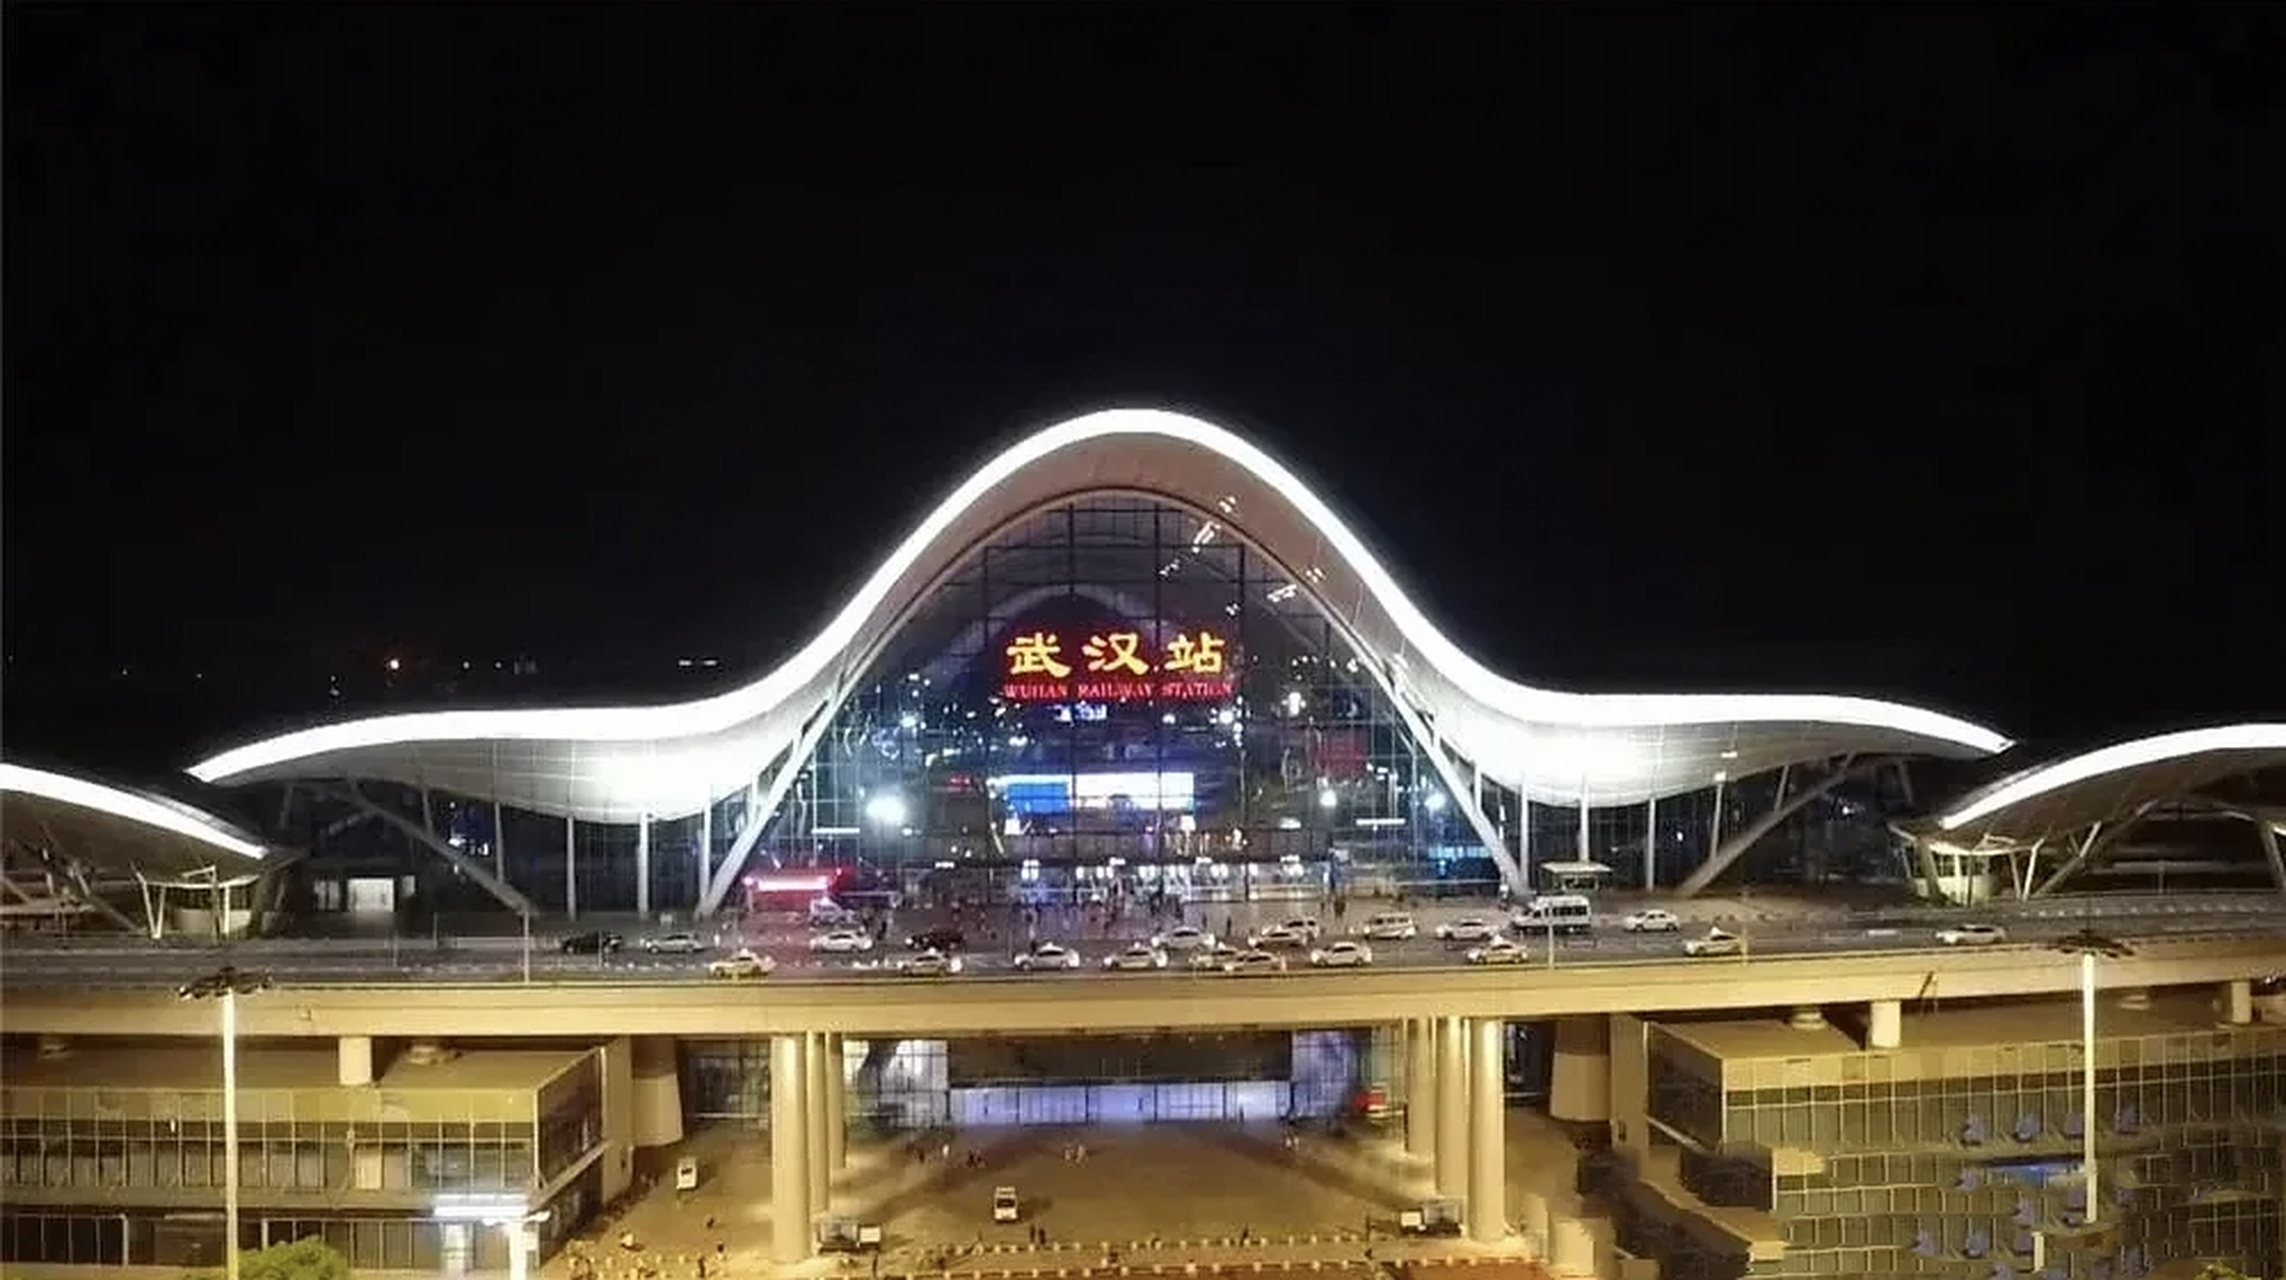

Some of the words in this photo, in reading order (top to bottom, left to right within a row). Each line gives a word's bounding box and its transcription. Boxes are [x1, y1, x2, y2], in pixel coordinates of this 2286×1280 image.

[1006, 632, 1225, 678] 武汉站
[1004, 684, 1068, 698] WUHAN
[1078, 682, 1152, 697] RAILWAY
